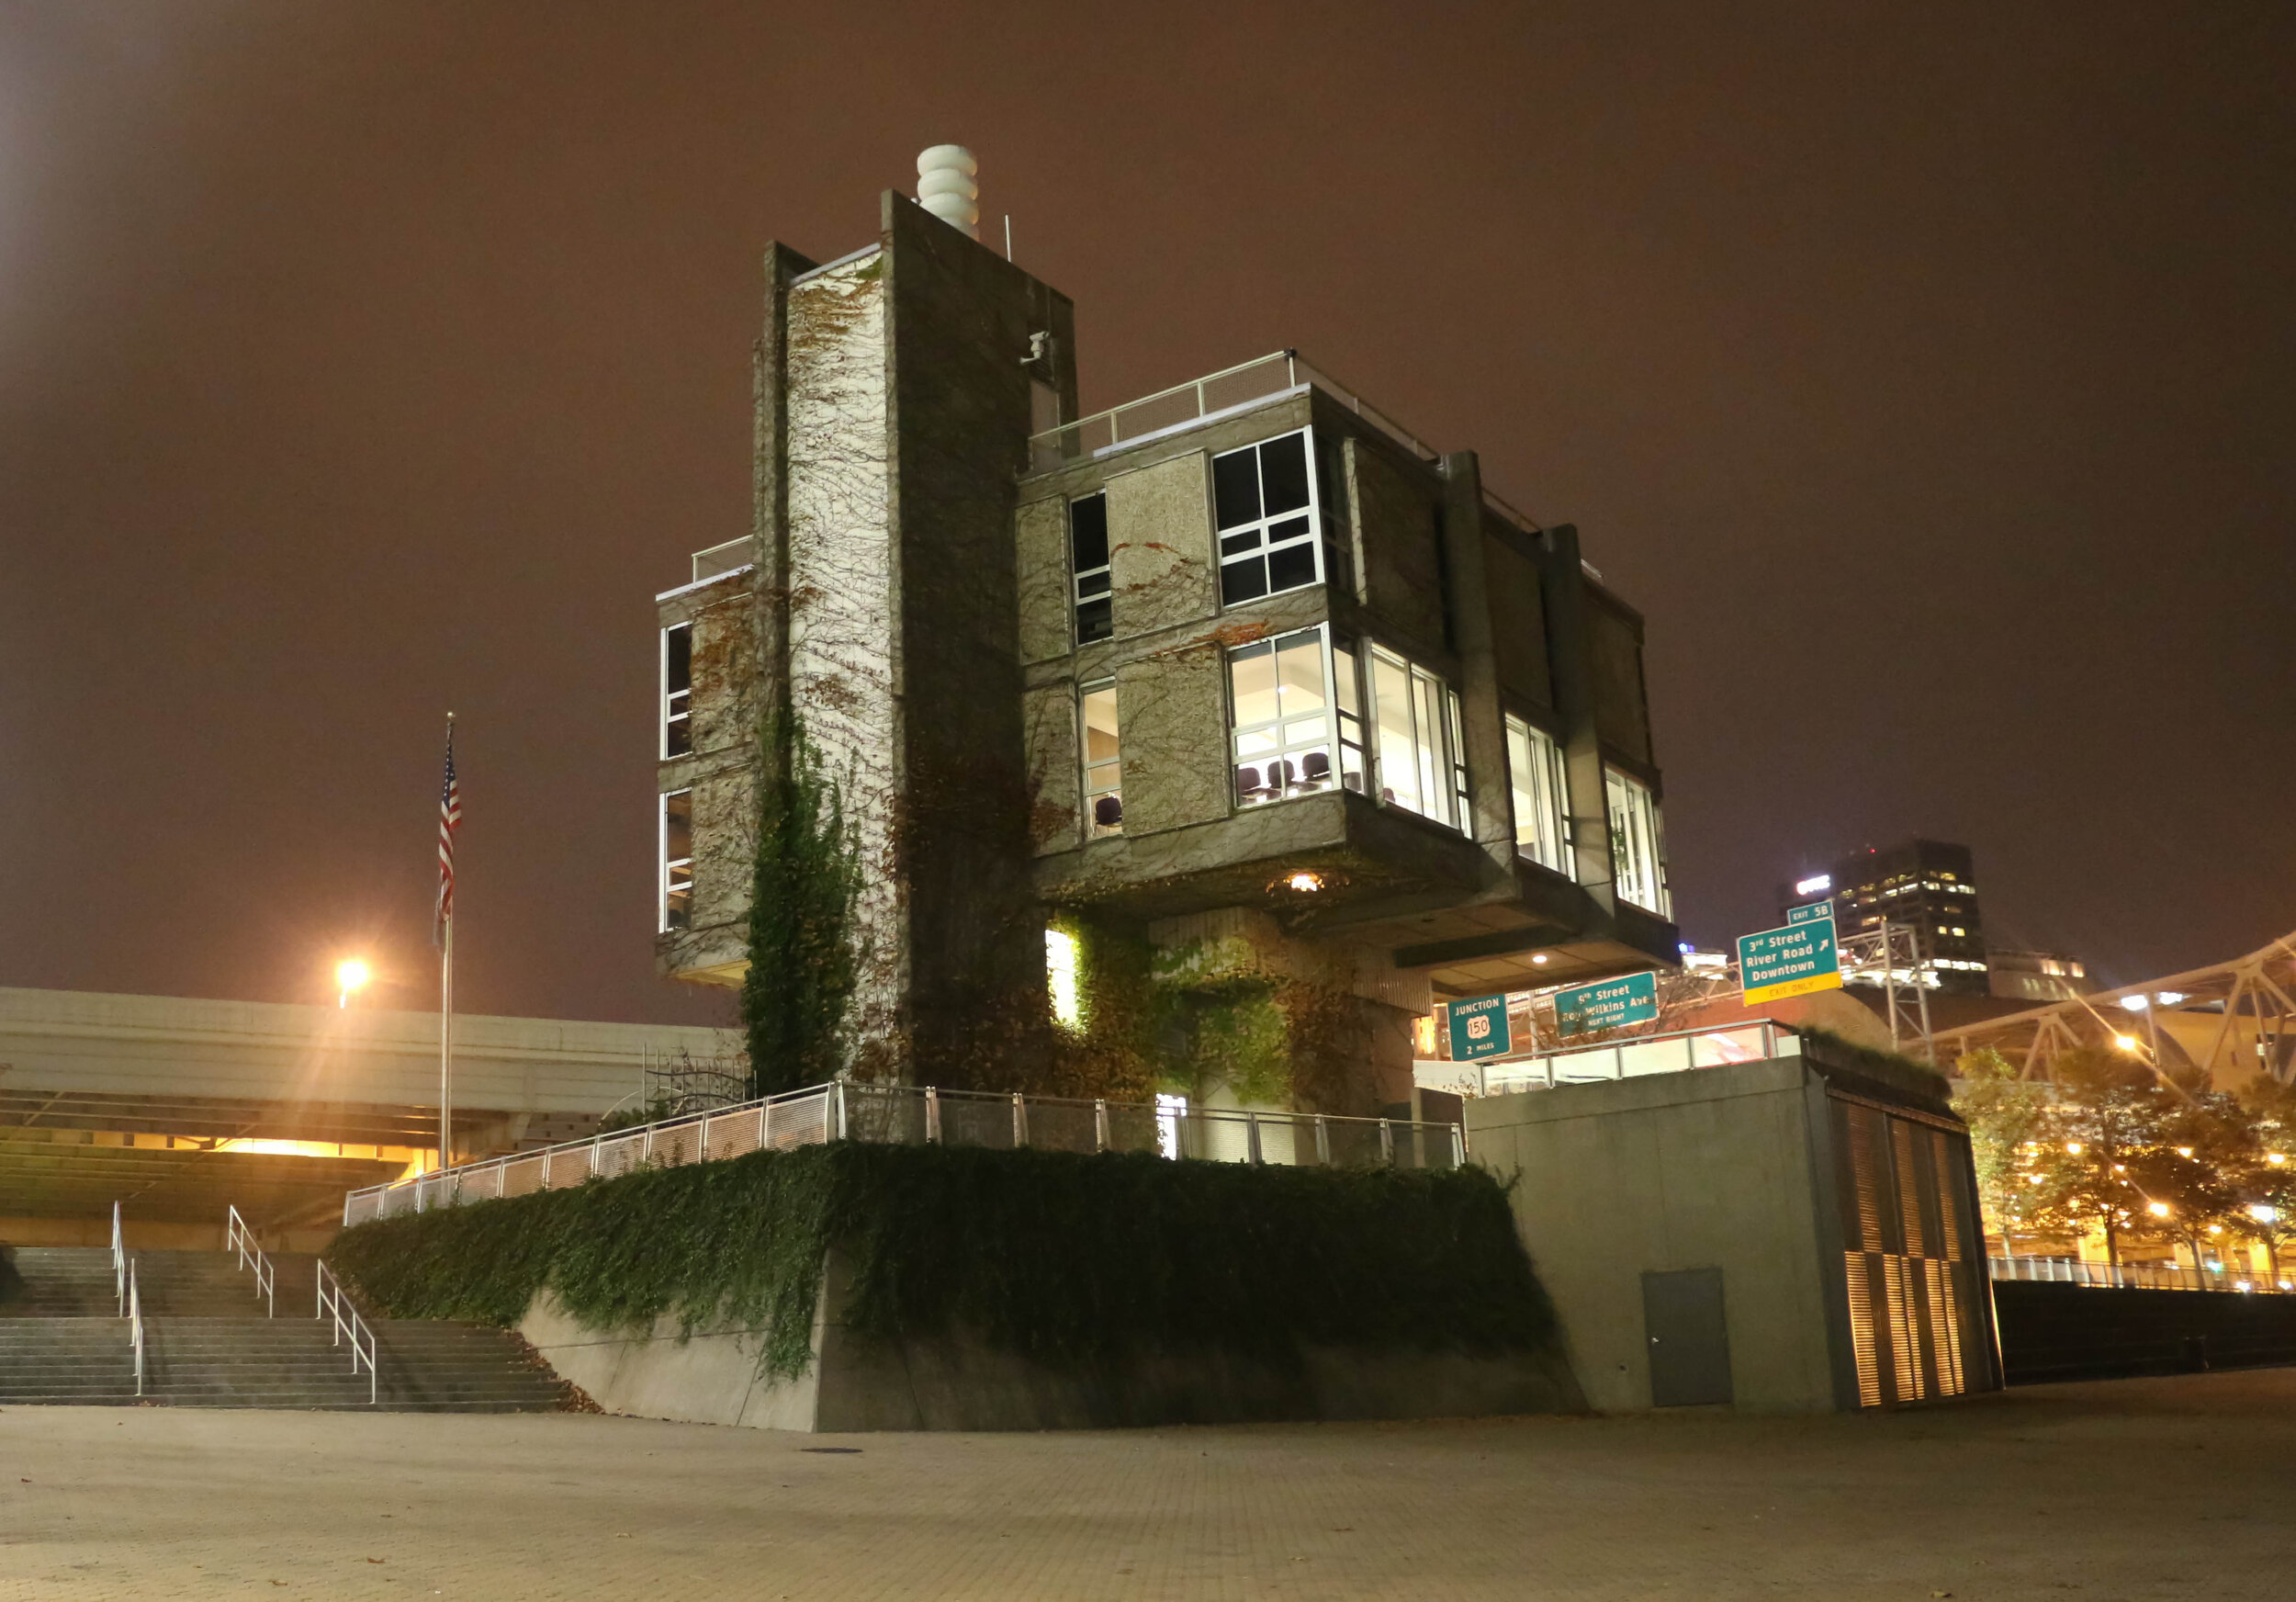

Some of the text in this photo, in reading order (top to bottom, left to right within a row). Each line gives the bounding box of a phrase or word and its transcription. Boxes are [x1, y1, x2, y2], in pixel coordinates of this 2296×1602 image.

[1793, 906, 1829, 920] EXIT 5B
[1749, 931, 1807, 953] 3rd Street
[1746, 944, 1813, 967] River Road
[1752, 961, 1816, 982] Downtown
[1596, 985, 1630, 1000] Street
[1769, 981, 1814, 997] EXIT ONLY
[1455, 998, 1500, 1016] JUNCTION
[1469, 1020, 1488, 1034] 150
[1588, 1013, 1625, 1027] NEXT RIGHT
[1467, 1043, 1494, 1055] 2 MILES
